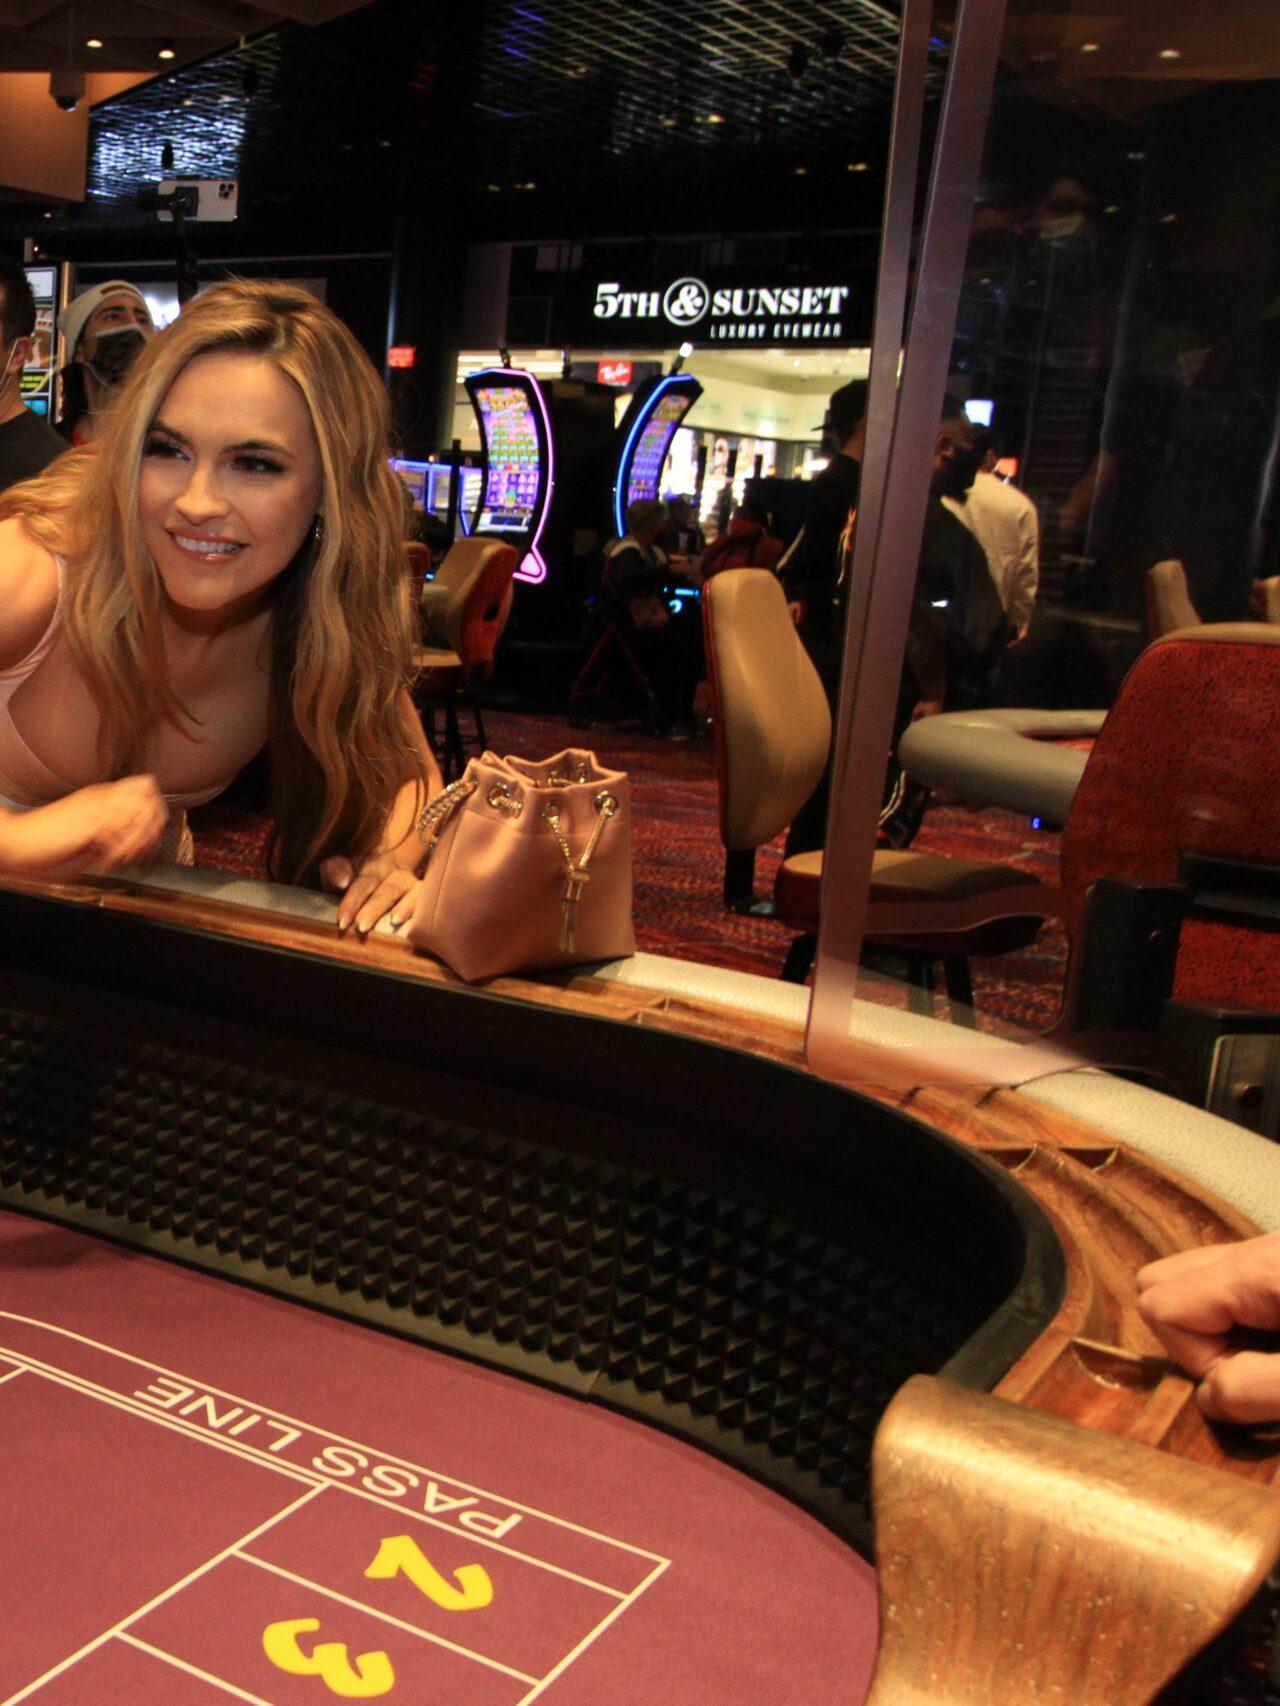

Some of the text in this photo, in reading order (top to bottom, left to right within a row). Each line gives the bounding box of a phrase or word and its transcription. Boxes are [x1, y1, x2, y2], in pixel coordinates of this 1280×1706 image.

[593, 281, 849, 320] 5TH & SUNSET
[710, 322, 843, 338] LUXURY EYEWEAR
[134, 1376, 524, 1541] PASS LINE
[364, 1535, 494, 1611] 2
[262, 1618, 396, 1698] 3
